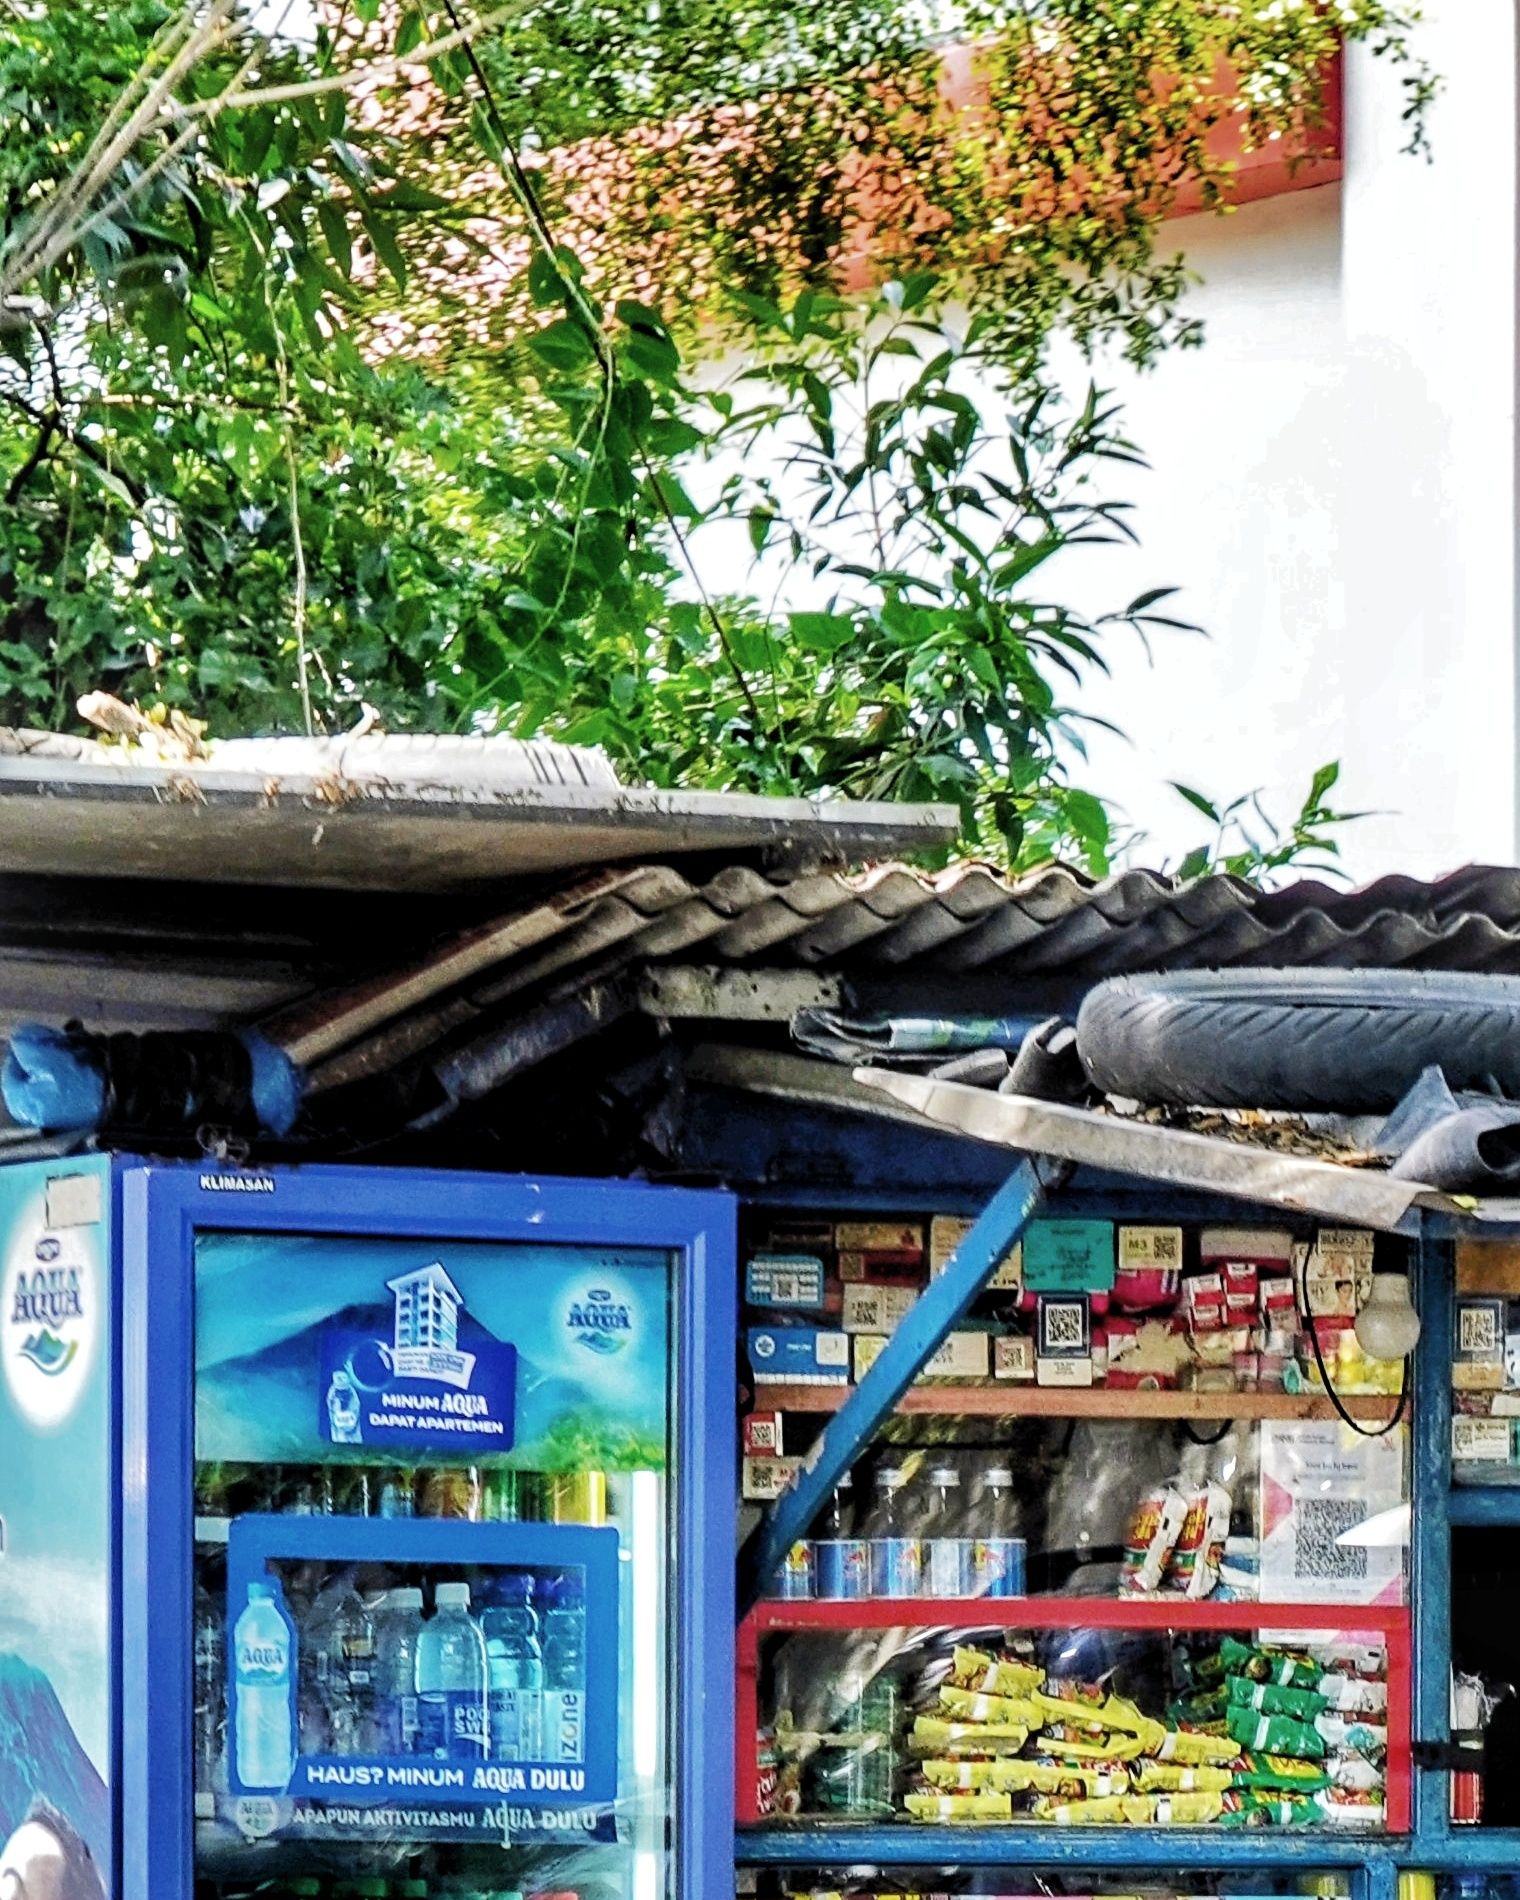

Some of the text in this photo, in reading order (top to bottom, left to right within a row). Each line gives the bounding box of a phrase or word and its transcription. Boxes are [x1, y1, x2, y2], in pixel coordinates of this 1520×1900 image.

[200, 1174, 275, 1192] KLIMASAN
[566, 1302, 632, 1332] AQUA
[382, 1392, 488, 1417] MINUM AQUA
[369, 1413, 504, 1434] DAPAT APARTEMEN
[240, 1647, 285, 1668] AQUA
[307, 1765, 585, 1793] HAUS? MINUM AQUA DULU
[292, 1808, 360, 1825] APAPUN
[362, 1809, 475, 1827] AKTIVITASMU
[482, 1808, 536, 1832] AQUA
[541, 1810, 597, 1831] DULU
